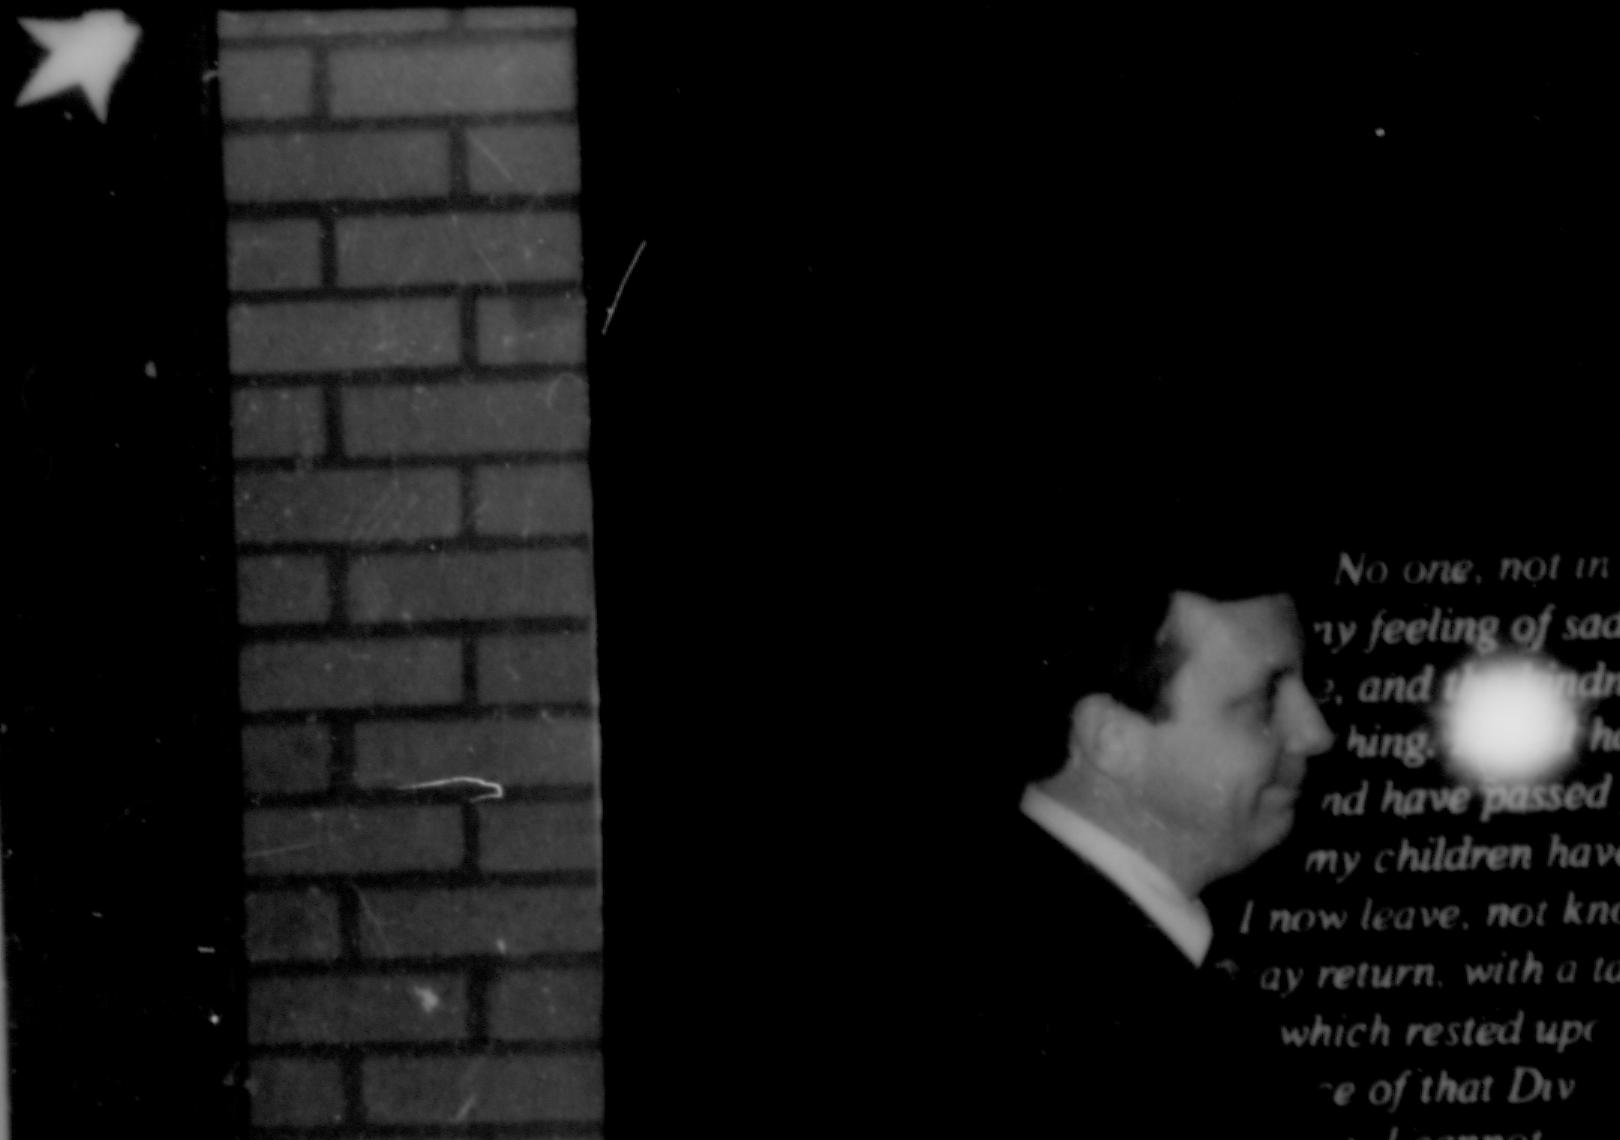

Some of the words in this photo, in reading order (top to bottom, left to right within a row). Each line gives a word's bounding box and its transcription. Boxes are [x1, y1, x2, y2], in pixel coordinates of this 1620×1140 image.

[1336, 551, 1389, 586] No
[1499, 553, 1562, 582] not
[1575, 556, 1610, 580] in
[1363, 606, 1500, 656] feeling
[1509, 602, 1557, 655] of
[1356, 663, 1437, 704] and
[1320, 779, 1370, 817] nd
[1379, 779, 1473, 817] have
[1480, 771, 1615, 822] passed
[1303, 849, 1362, 884] my
[1372, 834, 1533, 875] children
[1238, 899, 1255, 935] I
[1268, 905, 1349, 935] now
[1485, 900, 1549, 929] not
[1259, 965, 1306, 998] ay
[1464, 949, 1545, 987] with
[1555, 959, 1579, 984] a
[1279, 1012, 1392, 1049] which
[1404, 1008, 1526, 1048] rested
[1367, 1068, 1414, 1113] of
[1418, 1068, 1495, 1106] that
[1506, 1064, 1577, 1105] Div
